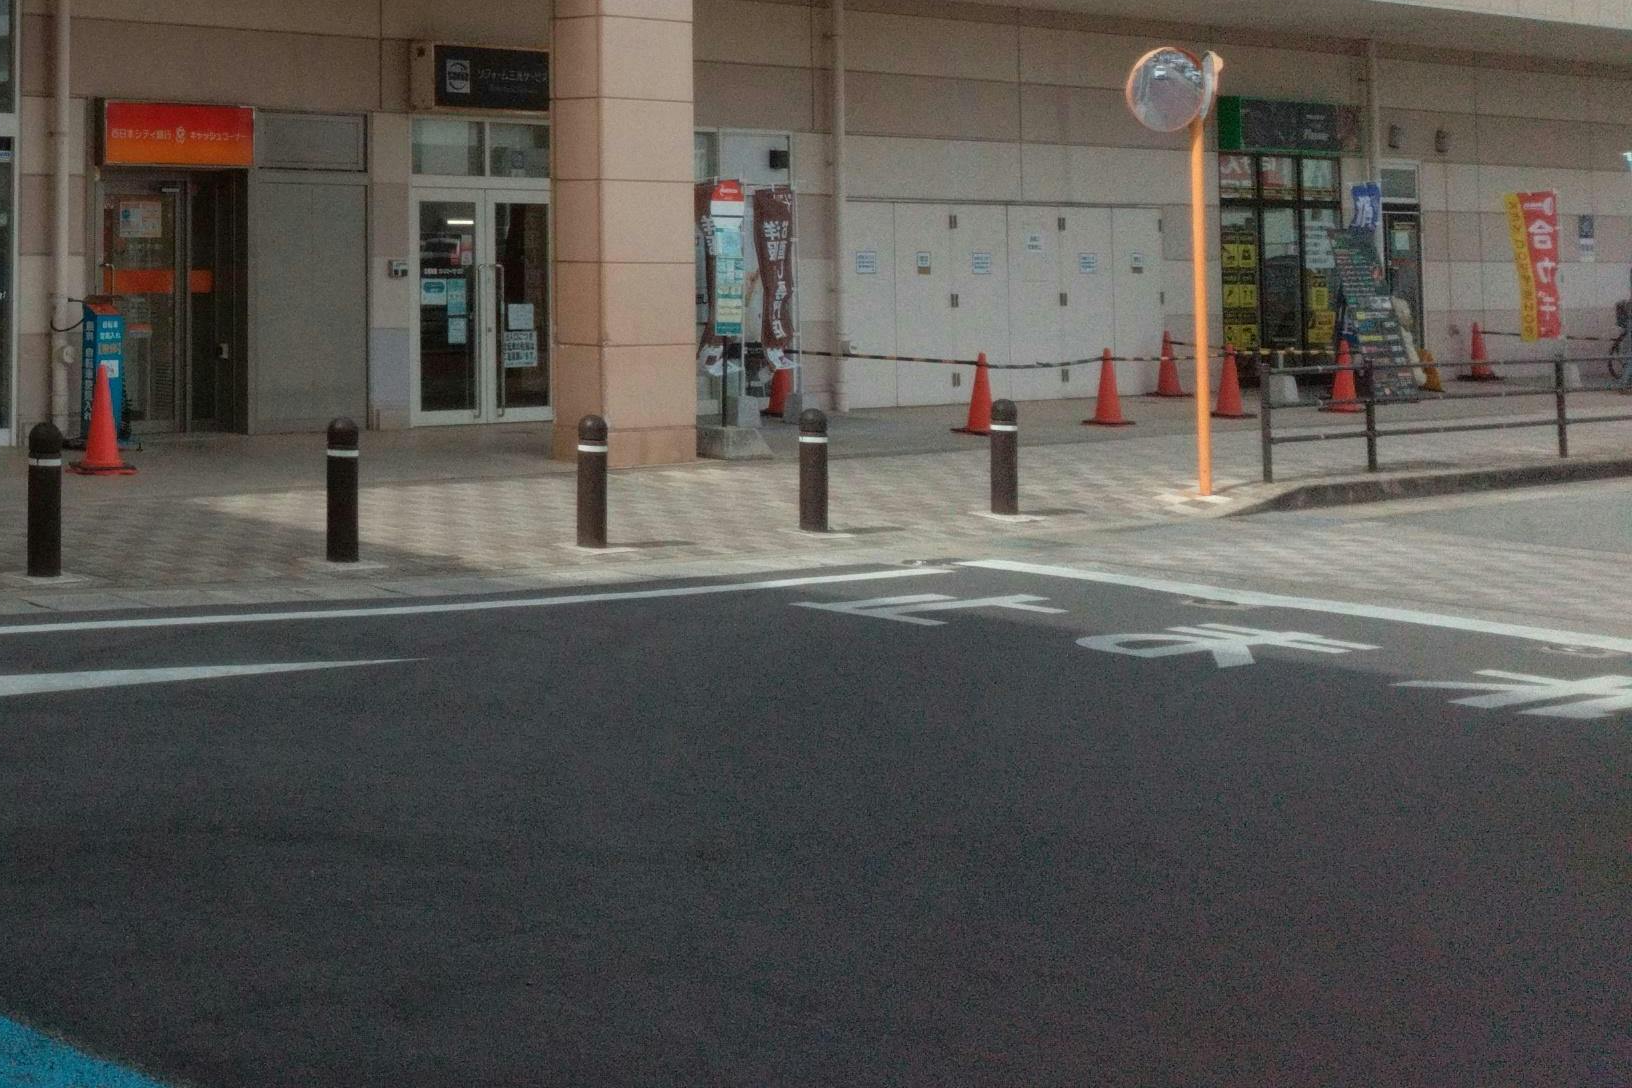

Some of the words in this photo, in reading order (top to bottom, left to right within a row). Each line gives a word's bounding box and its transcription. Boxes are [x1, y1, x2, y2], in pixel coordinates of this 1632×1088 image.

[111, 127, 174, 141] 西日本シティ銀行
